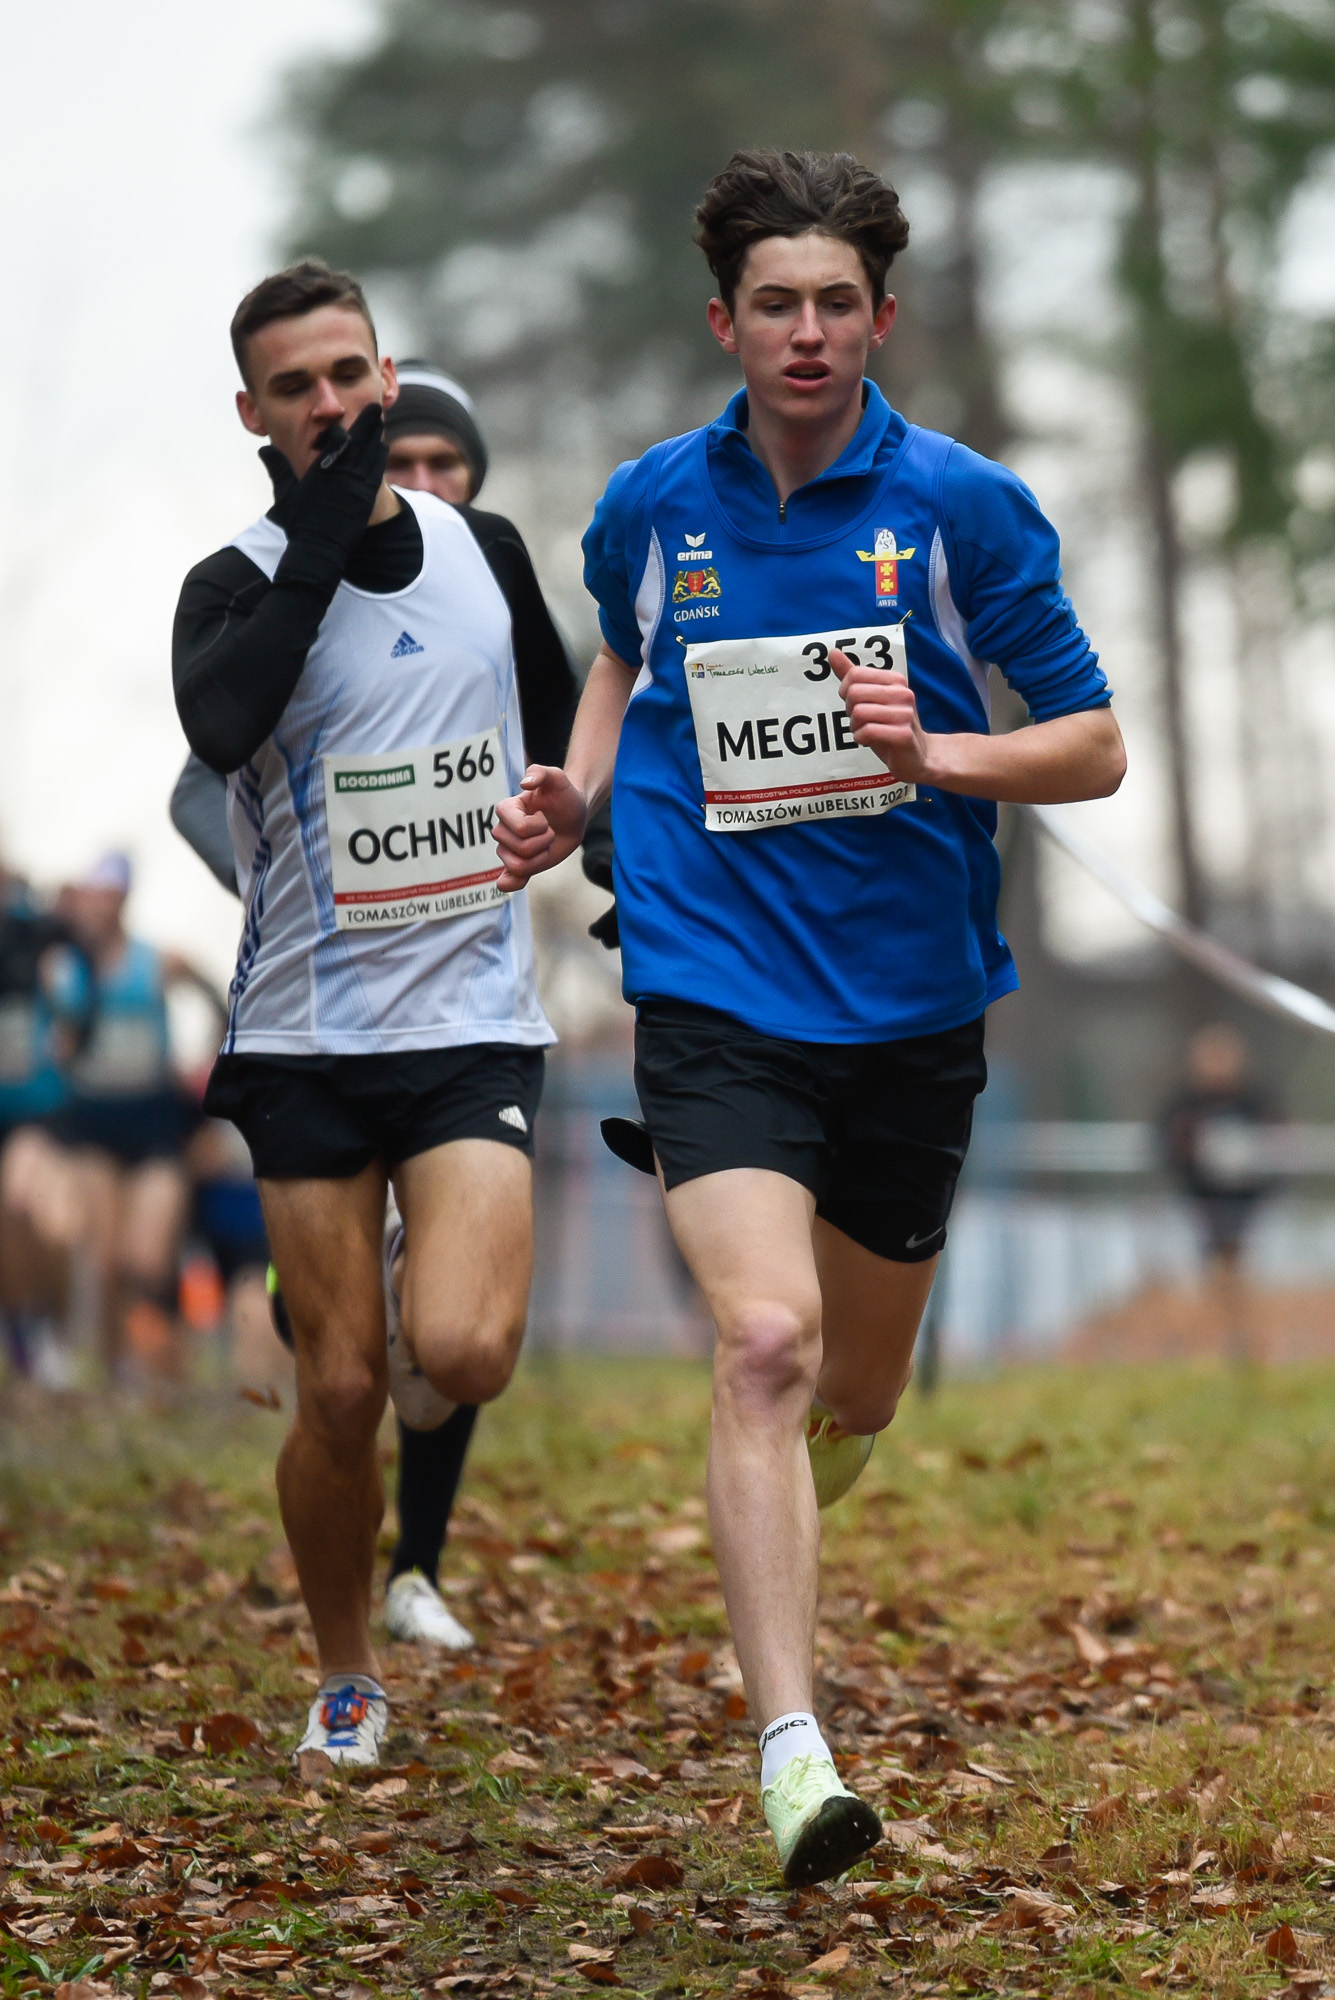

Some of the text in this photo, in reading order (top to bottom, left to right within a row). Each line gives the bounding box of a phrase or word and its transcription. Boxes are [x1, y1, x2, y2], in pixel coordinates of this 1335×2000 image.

[677, 550, 713, 561] erima
[673, 605, 720, 622] GDAŃSK
[390, 644, 425, 659] adidas
[716, 711, 871, 762] MEGIE
[338, 769, 411, 789] BOGDANKA
[432, 739, 495, 788] 566
[716, 785, 909, 824] TOMASZÓW LUBELSKI 2021
[348, 804, 495, 865] OCHNIK
[347, 900, 429, 923] TOMASZÓW
[435, 889, 486, 913] LUBELSKI
